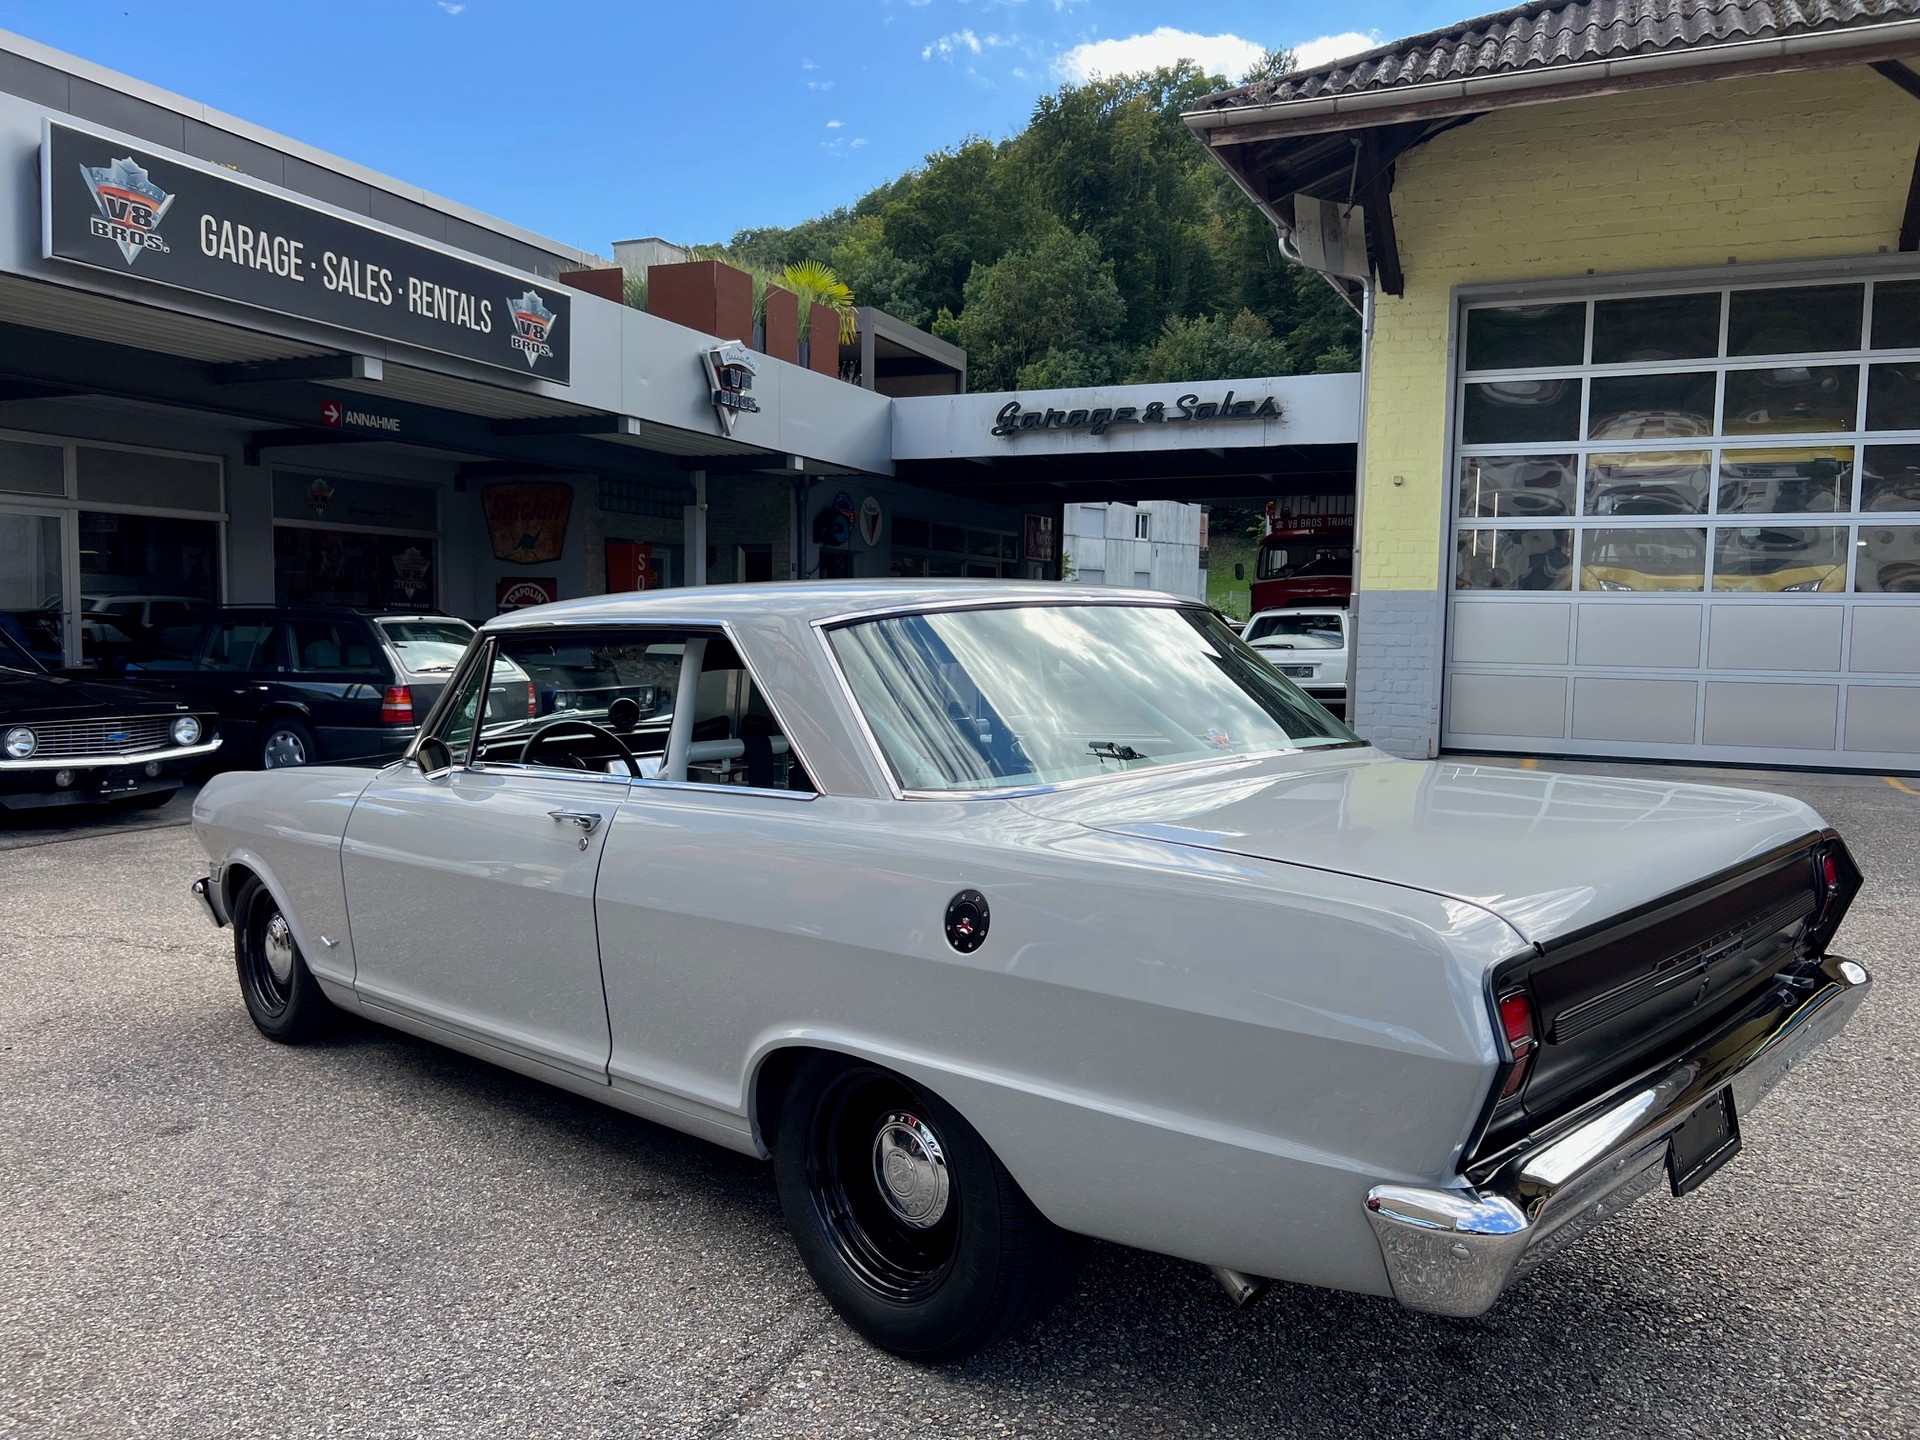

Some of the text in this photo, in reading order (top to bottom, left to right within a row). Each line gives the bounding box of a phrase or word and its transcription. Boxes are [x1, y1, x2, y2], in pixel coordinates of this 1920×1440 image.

[103, 192, 154, 230] V8
[200, 213, 493, 334] GARAGE SALES RENTALS
[518, 317, 545, 342] V8
[345, 410, 401, 432] ANNAHME
[991, 390, 1284, 436] Garage & Sales
[1287, 518, 1298, 529] V8
[508, 586, 546, 605] DAPOLIN
